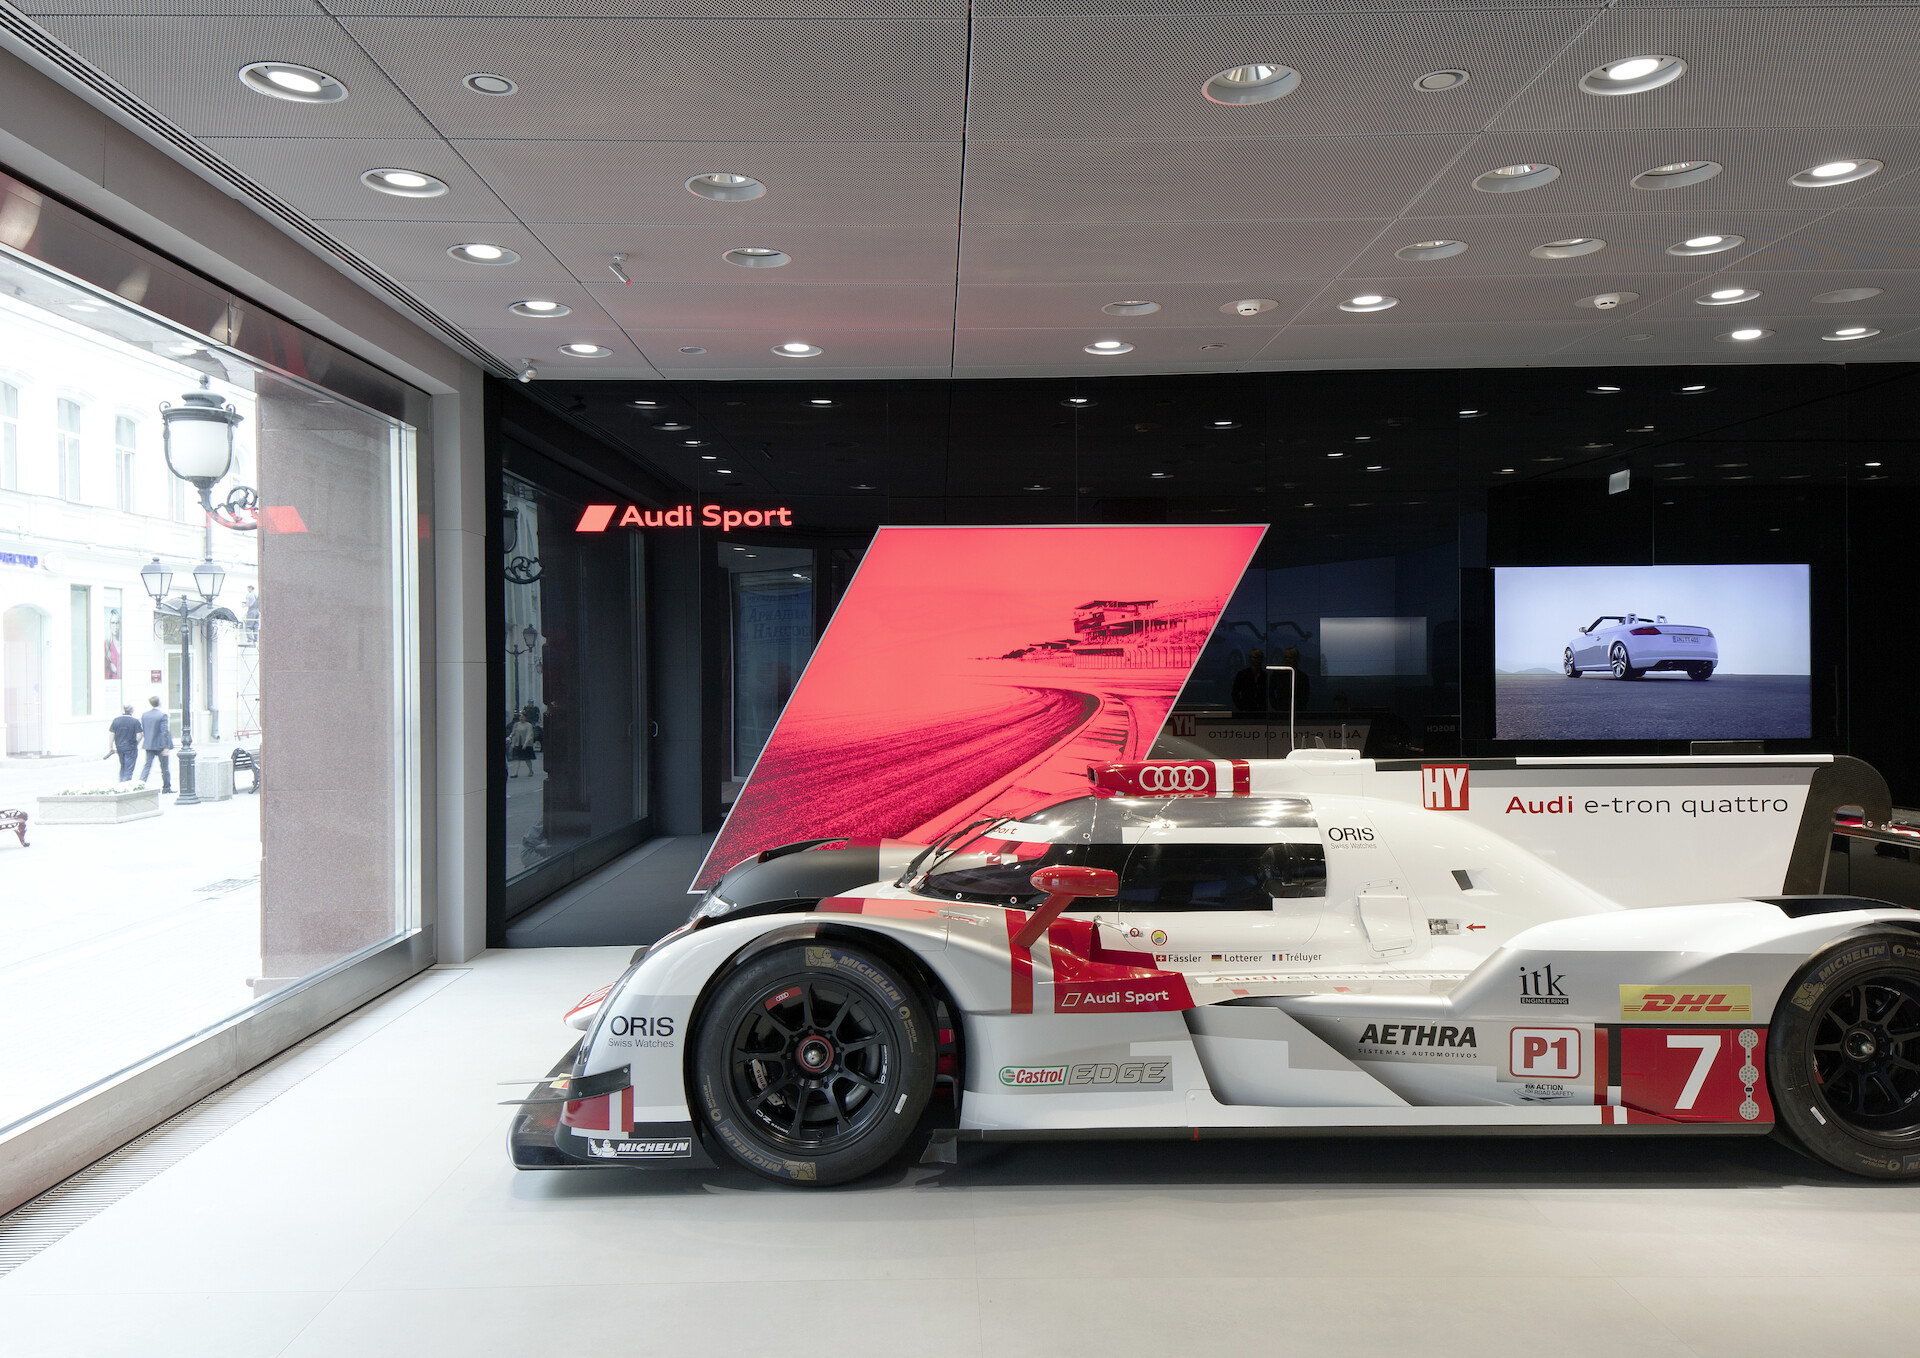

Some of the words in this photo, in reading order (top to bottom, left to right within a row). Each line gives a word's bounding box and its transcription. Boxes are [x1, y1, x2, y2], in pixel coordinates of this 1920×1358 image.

[618, 505, 693, 527] Audi
[702, 504, 793, 532] Sport
[1423, 768, 1467, 808] HY
[1505, 796, 1573, 814] Audi
[1584, 797, 1671, 813] e-tron
[1681, 797, 1789, 818] quattro
[1328, 827, 1375, 841] ORIS
[1168, 954, 1202, 963] Fässler
[1224, 953, 1263, 962] Lotterer
[1285, 953, 1322, 963] Tréluyer
[1818, 943, 1887, 981] MICHELIN
[838, 955, 902, 1002] MICHELIN
[1519, 963, 1568, 996] itk
[1083, 992, 1120, 1004] Audi
[1125, 990, 1170, 1005] Sport
[1640, 994, 1733, 1012] DHL
[610, 1015, 674, 1036] ORIS
[1358, 1023, 1478, 1048] AETHRA
[608, 1038, 633, 1048] Swiss
[635, 1039, 675, 1048] Watches
[1358, 1048, 1406, 1056] SISTEMAS
[1523, 1036, 1567, 1070] P1
[1016, 1068, 1064, 1084] Castrol
[1068, 1062, 1170, 1085] EDGE
[1666, 1035, 1722, 1110] 7
[616, 1142, 689, 1152] MICHELIN
[718, 1125, 783, 1173] MICHELIN
